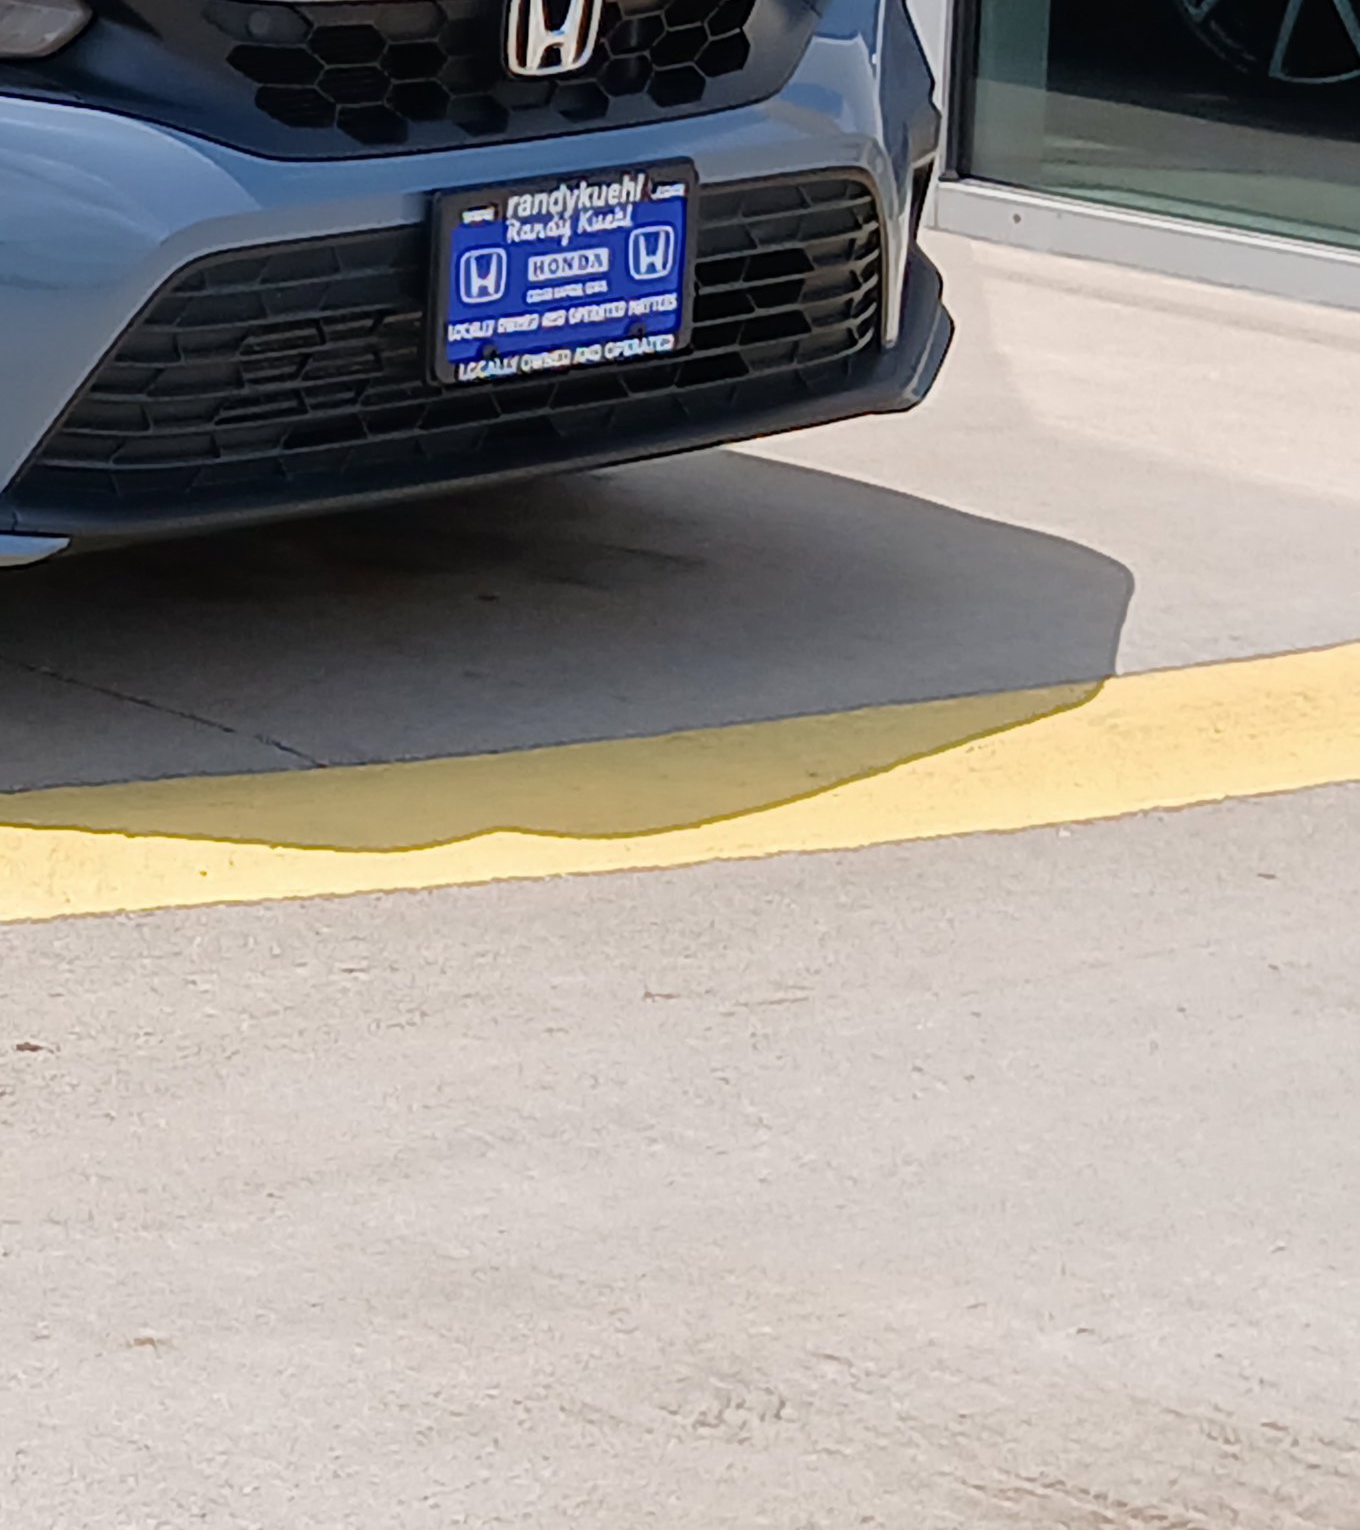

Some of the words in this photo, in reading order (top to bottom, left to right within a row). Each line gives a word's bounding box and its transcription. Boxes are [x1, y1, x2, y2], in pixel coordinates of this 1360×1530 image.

[506, 173, 645, 220] randykuehl
[506, 218, 571, 247] Randy
[577, 204, 633, 233] Kuehl
[533, 253, 604, 277] HONDA
[458, 355, 519, 381] LOCALLY
